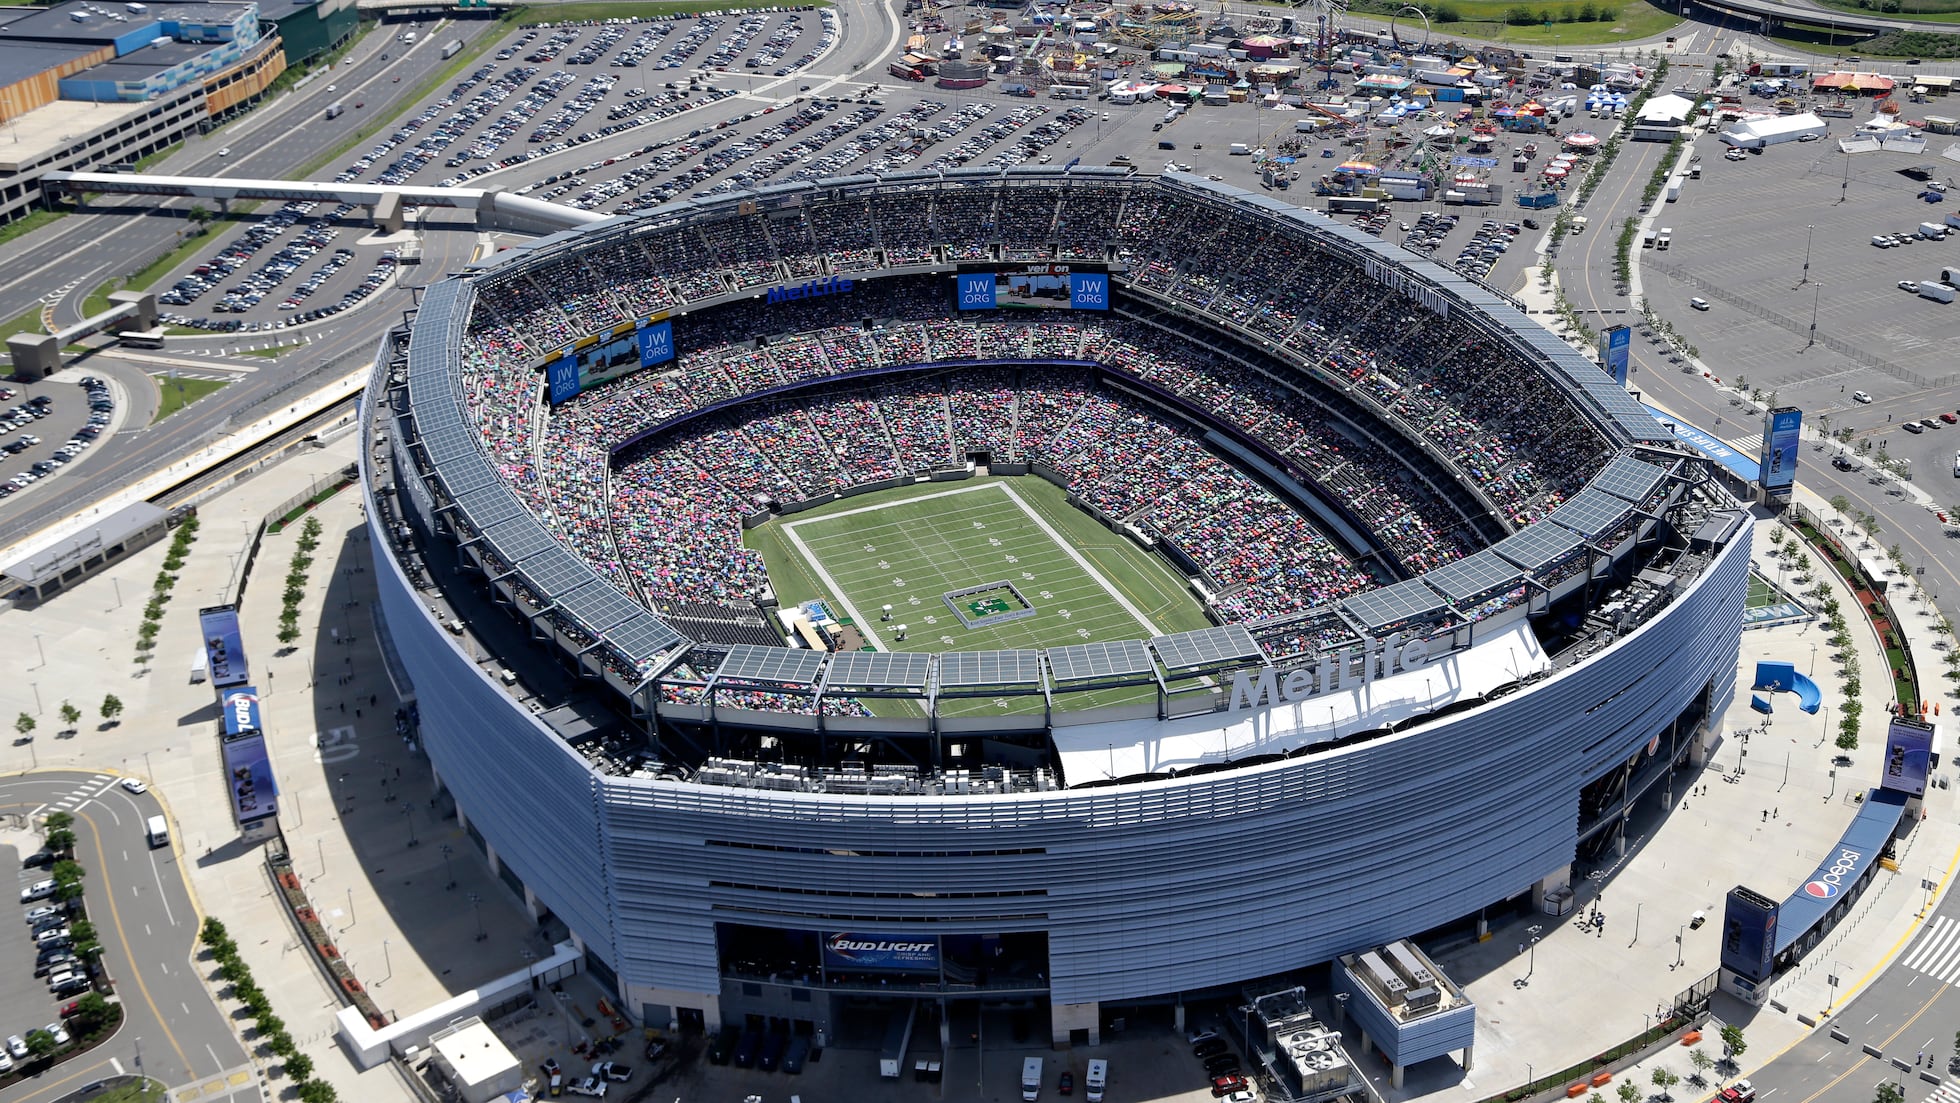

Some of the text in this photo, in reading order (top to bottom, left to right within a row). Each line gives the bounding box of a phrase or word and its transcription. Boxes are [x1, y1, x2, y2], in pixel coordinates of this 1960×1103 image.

[1027, 263, 1070, 273] verizon
[767, 275, 854, 304] MetLife
[965, 280, 989, 293] JW
[1077, 280, 1101, 293] JW
[1365, 259, 1449, 320] METLIFE STADIUM
[645, 330, 666, 349] JW
[555, 365, 573, 384] JW
[1689, 435, 1733, 457] METLIFE
[1228, 632, 1428, 712] MetLife
[234, 699, 251, 724] BUD
[1823, 849, 1861, 886] pepsi
[834, 940, 934, 952] BUD LIGHT
